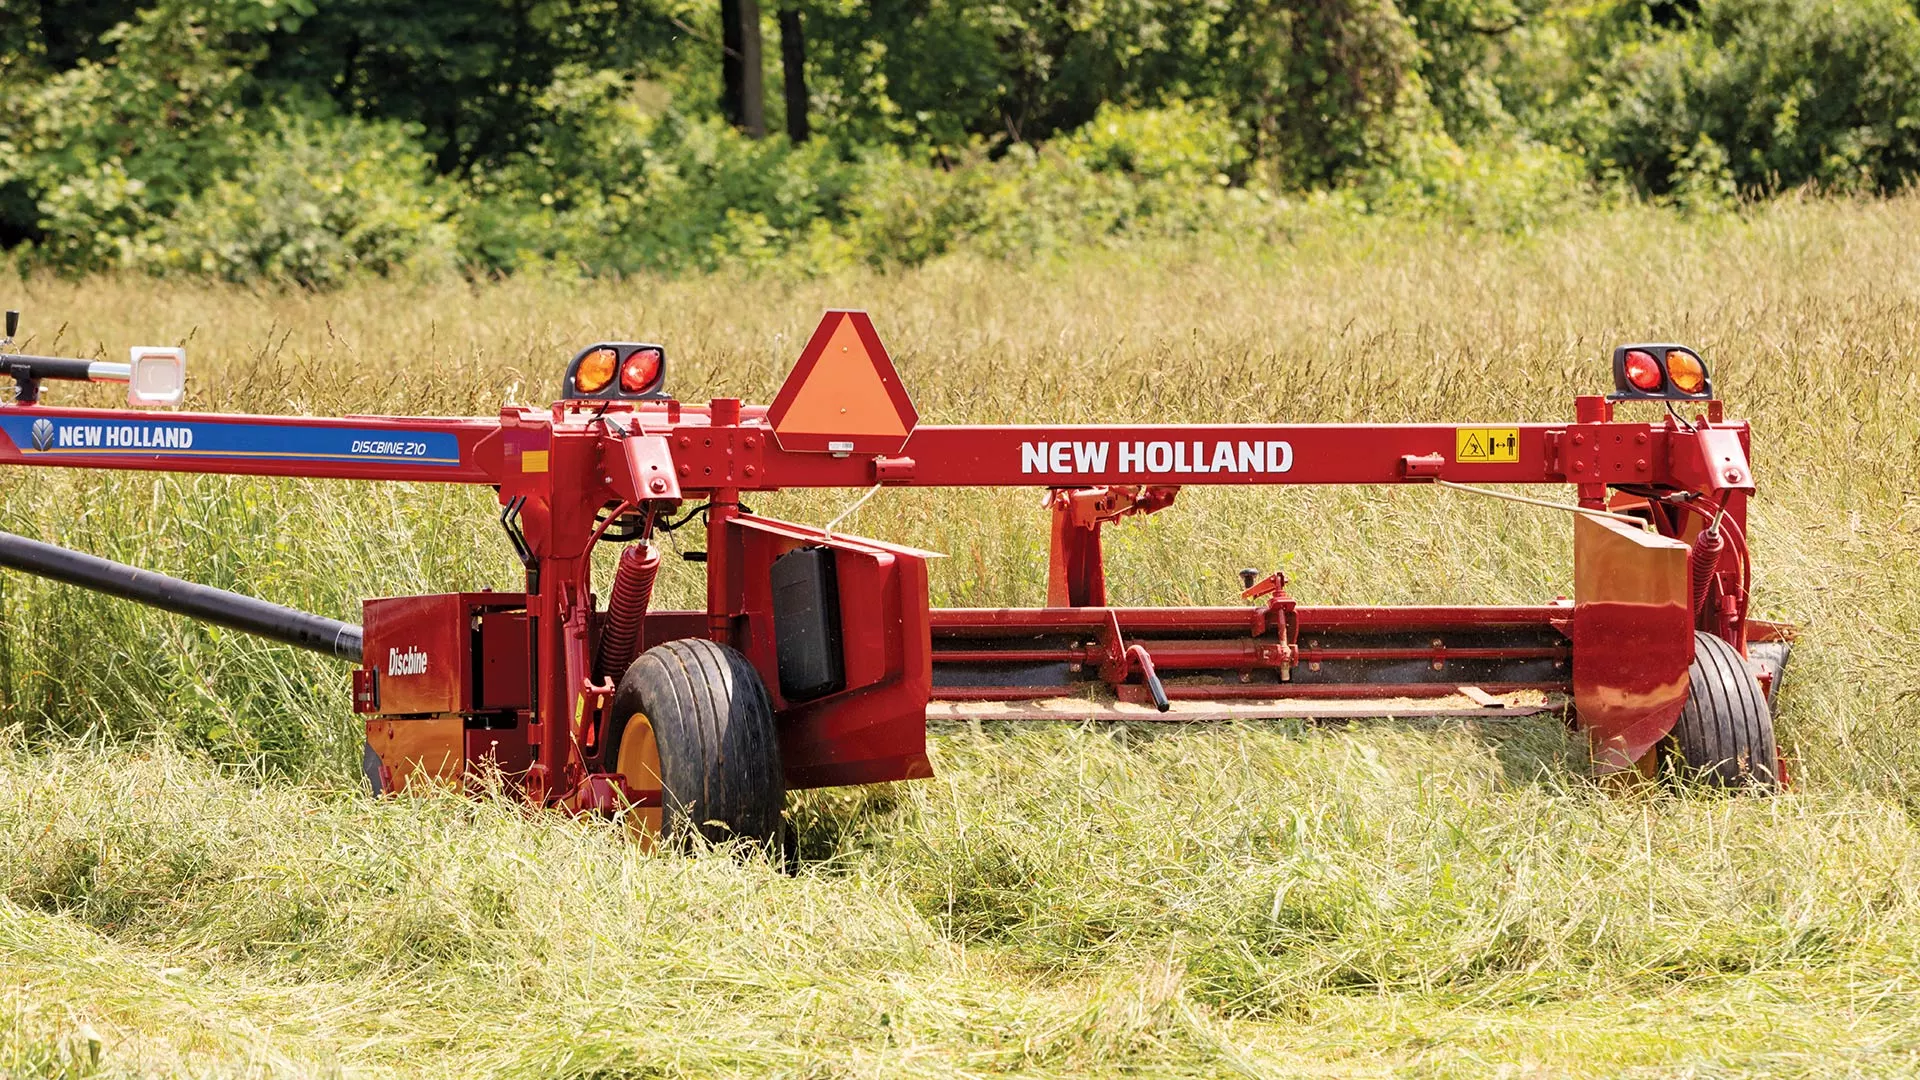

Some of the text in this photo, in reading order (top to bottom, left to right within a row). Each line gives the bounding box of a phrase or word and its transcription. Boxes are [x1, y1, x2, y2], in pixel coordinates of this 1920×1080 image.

[59, 426, 193, 449] NEW HOLLAND
[351, 440, 427, 456] DISCBINE 210
[1021, 441, 1294, 474] NEW HOLLAND
[388, 645, 428, 676] Discbine
